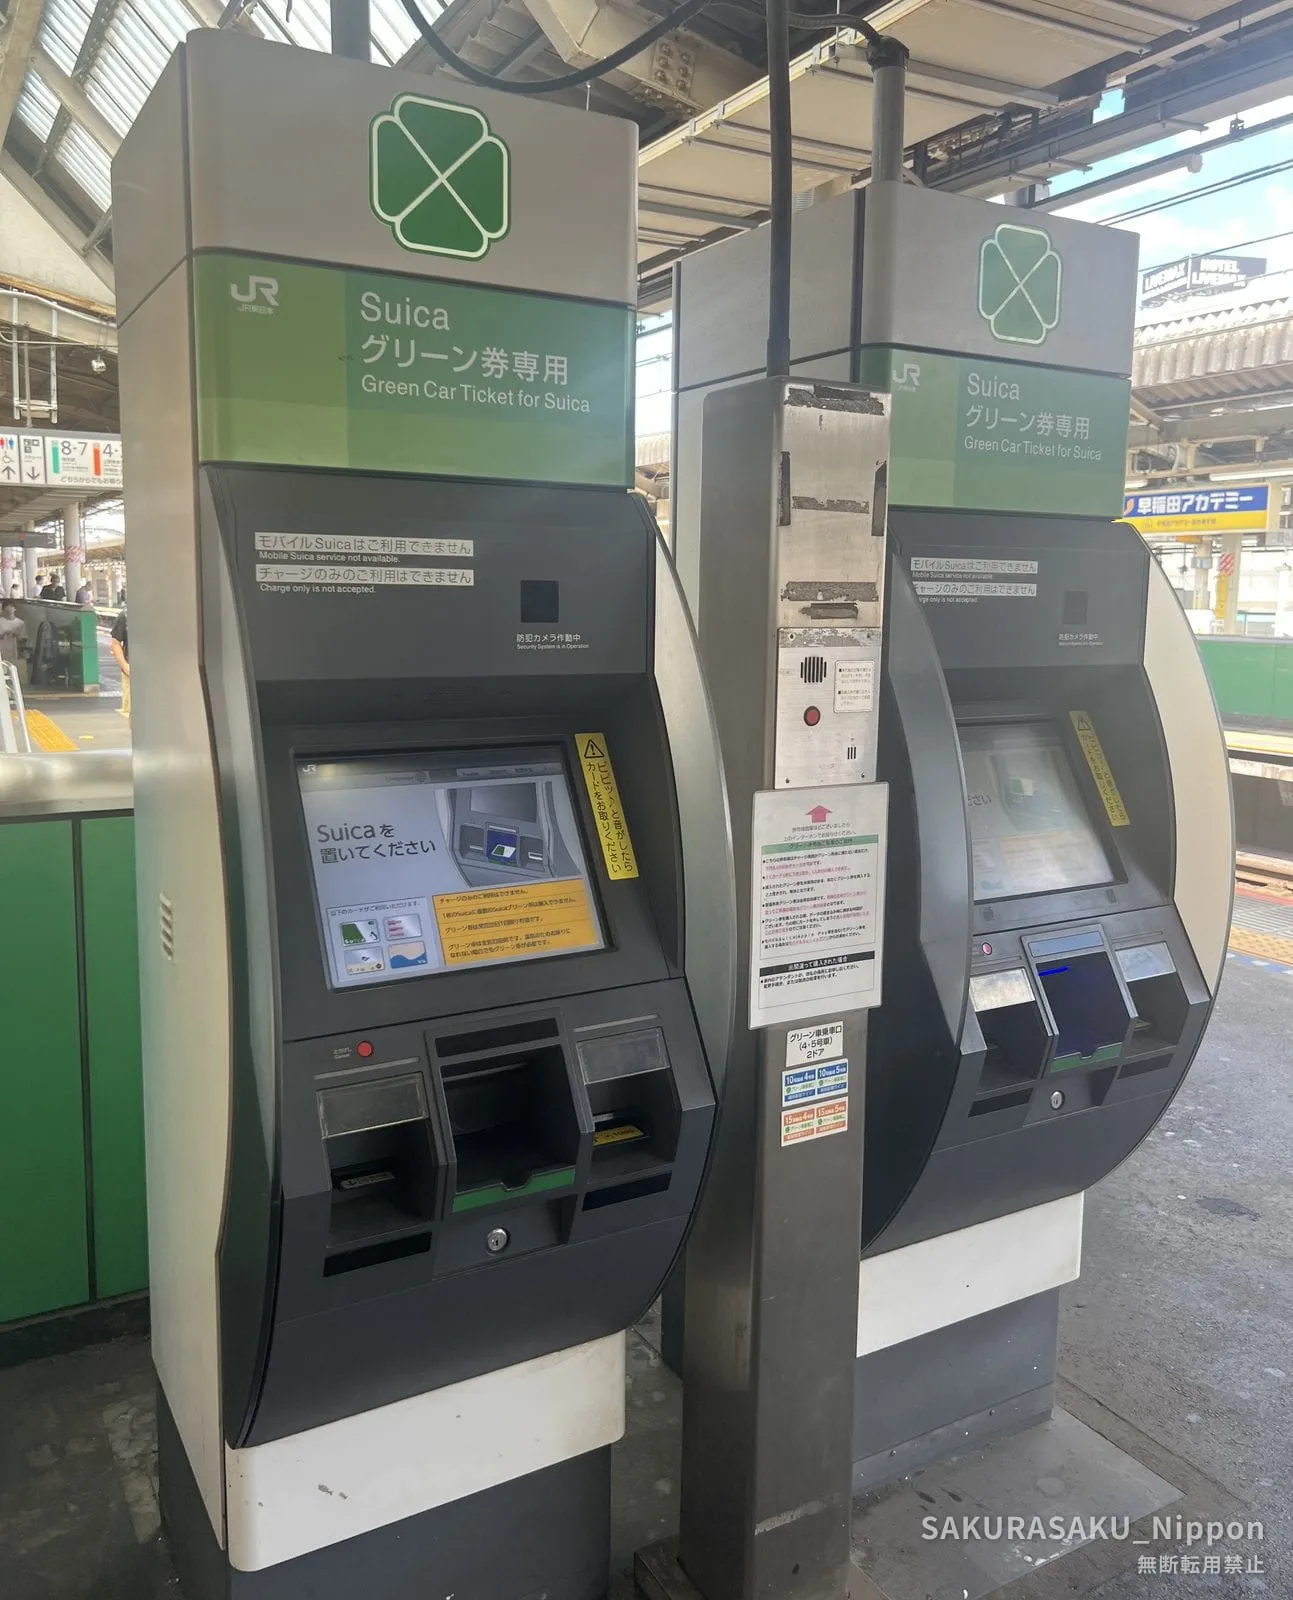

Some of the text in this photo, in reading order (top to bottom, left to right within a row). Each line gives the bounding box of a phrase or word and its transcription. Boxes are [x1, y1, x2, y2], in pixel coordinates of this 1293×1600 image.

[230, 275, 279, 306] JR
[361, 291, 450, 331] Suica
[361, 333, 569, 386] グリーン券専用
[892, 363, 920, 386] JR
[967, 372, 1020, 401] Suica
[361, 374, 591, 414] Green Car Ticket for Suica
[965, 404, 1091, 441] グリーン券専用
[964, 435, 1102, 460] Green Car Ticket for Suica
[1137, 491, 1254, 515] 早稲田アカデミー
[258, 534, 472, 556] モバイルSuicaはご利用できません
[259, 551, 401, 564] Mobile Suica service not available.
[258, 566, 472, 585] チャージのみのご利用はできません
[260, 584, 377, 595] Charge only is not accepted.
[516, 633, 581, 643] 防犯カメラ作動中
[302, 764, 317, 773] JR
[587, 762, 622, 873] カードをお取りください
[320, 840, 436, 865] 置いてください
[789, 1024, 842, 1043] グリーン車乗車口
[806, 1048, 825, 1059] 2ドア
